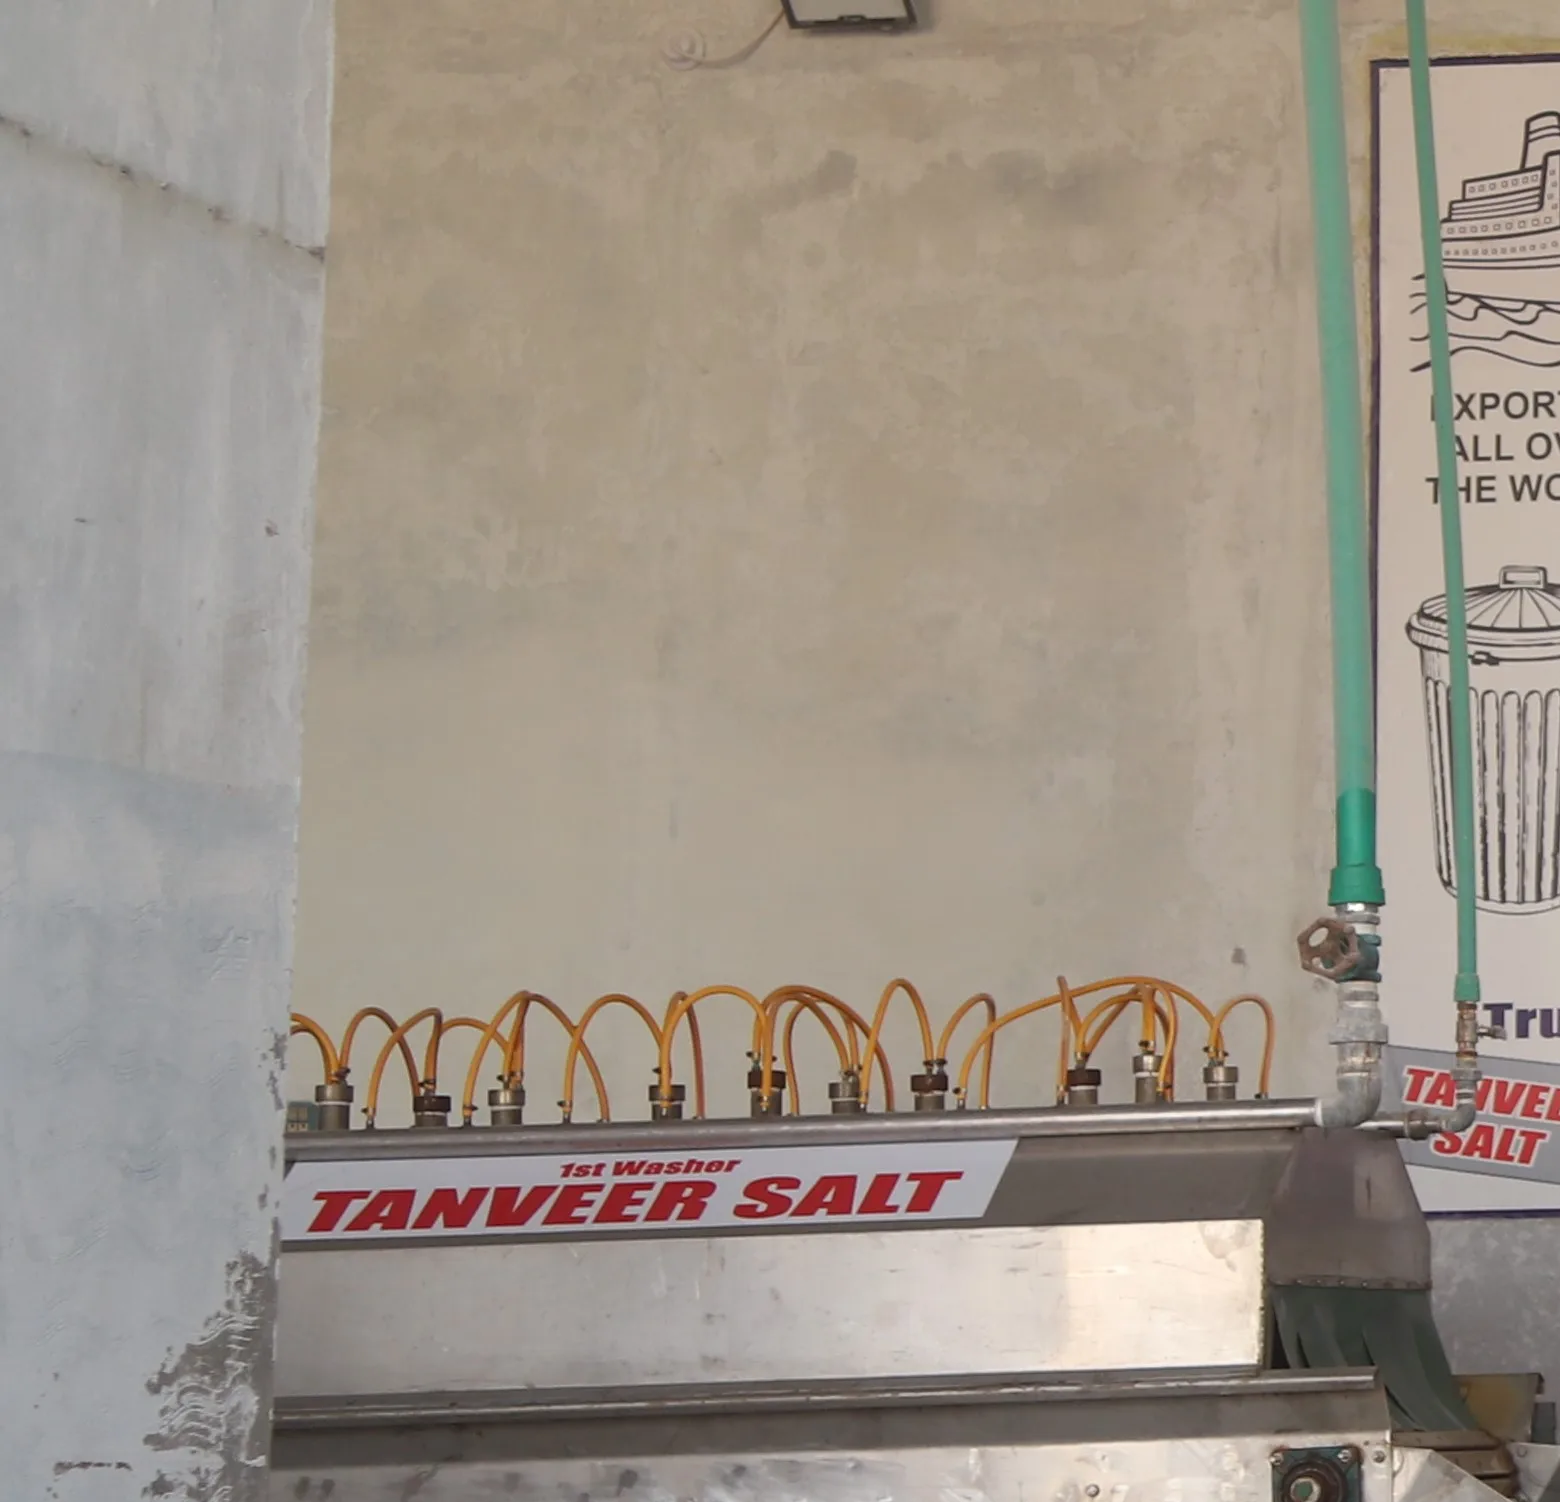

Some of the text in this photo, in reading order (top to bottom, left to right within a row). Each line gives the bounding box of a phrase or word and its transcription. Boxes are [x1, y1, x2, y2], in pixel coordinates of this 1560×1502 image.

[1433, 1124, 1547, 1165] SALT
[560, 1158, 741, 1178] 1st Washer
[306, 1170, 964, 1234] TANVEER SALT
